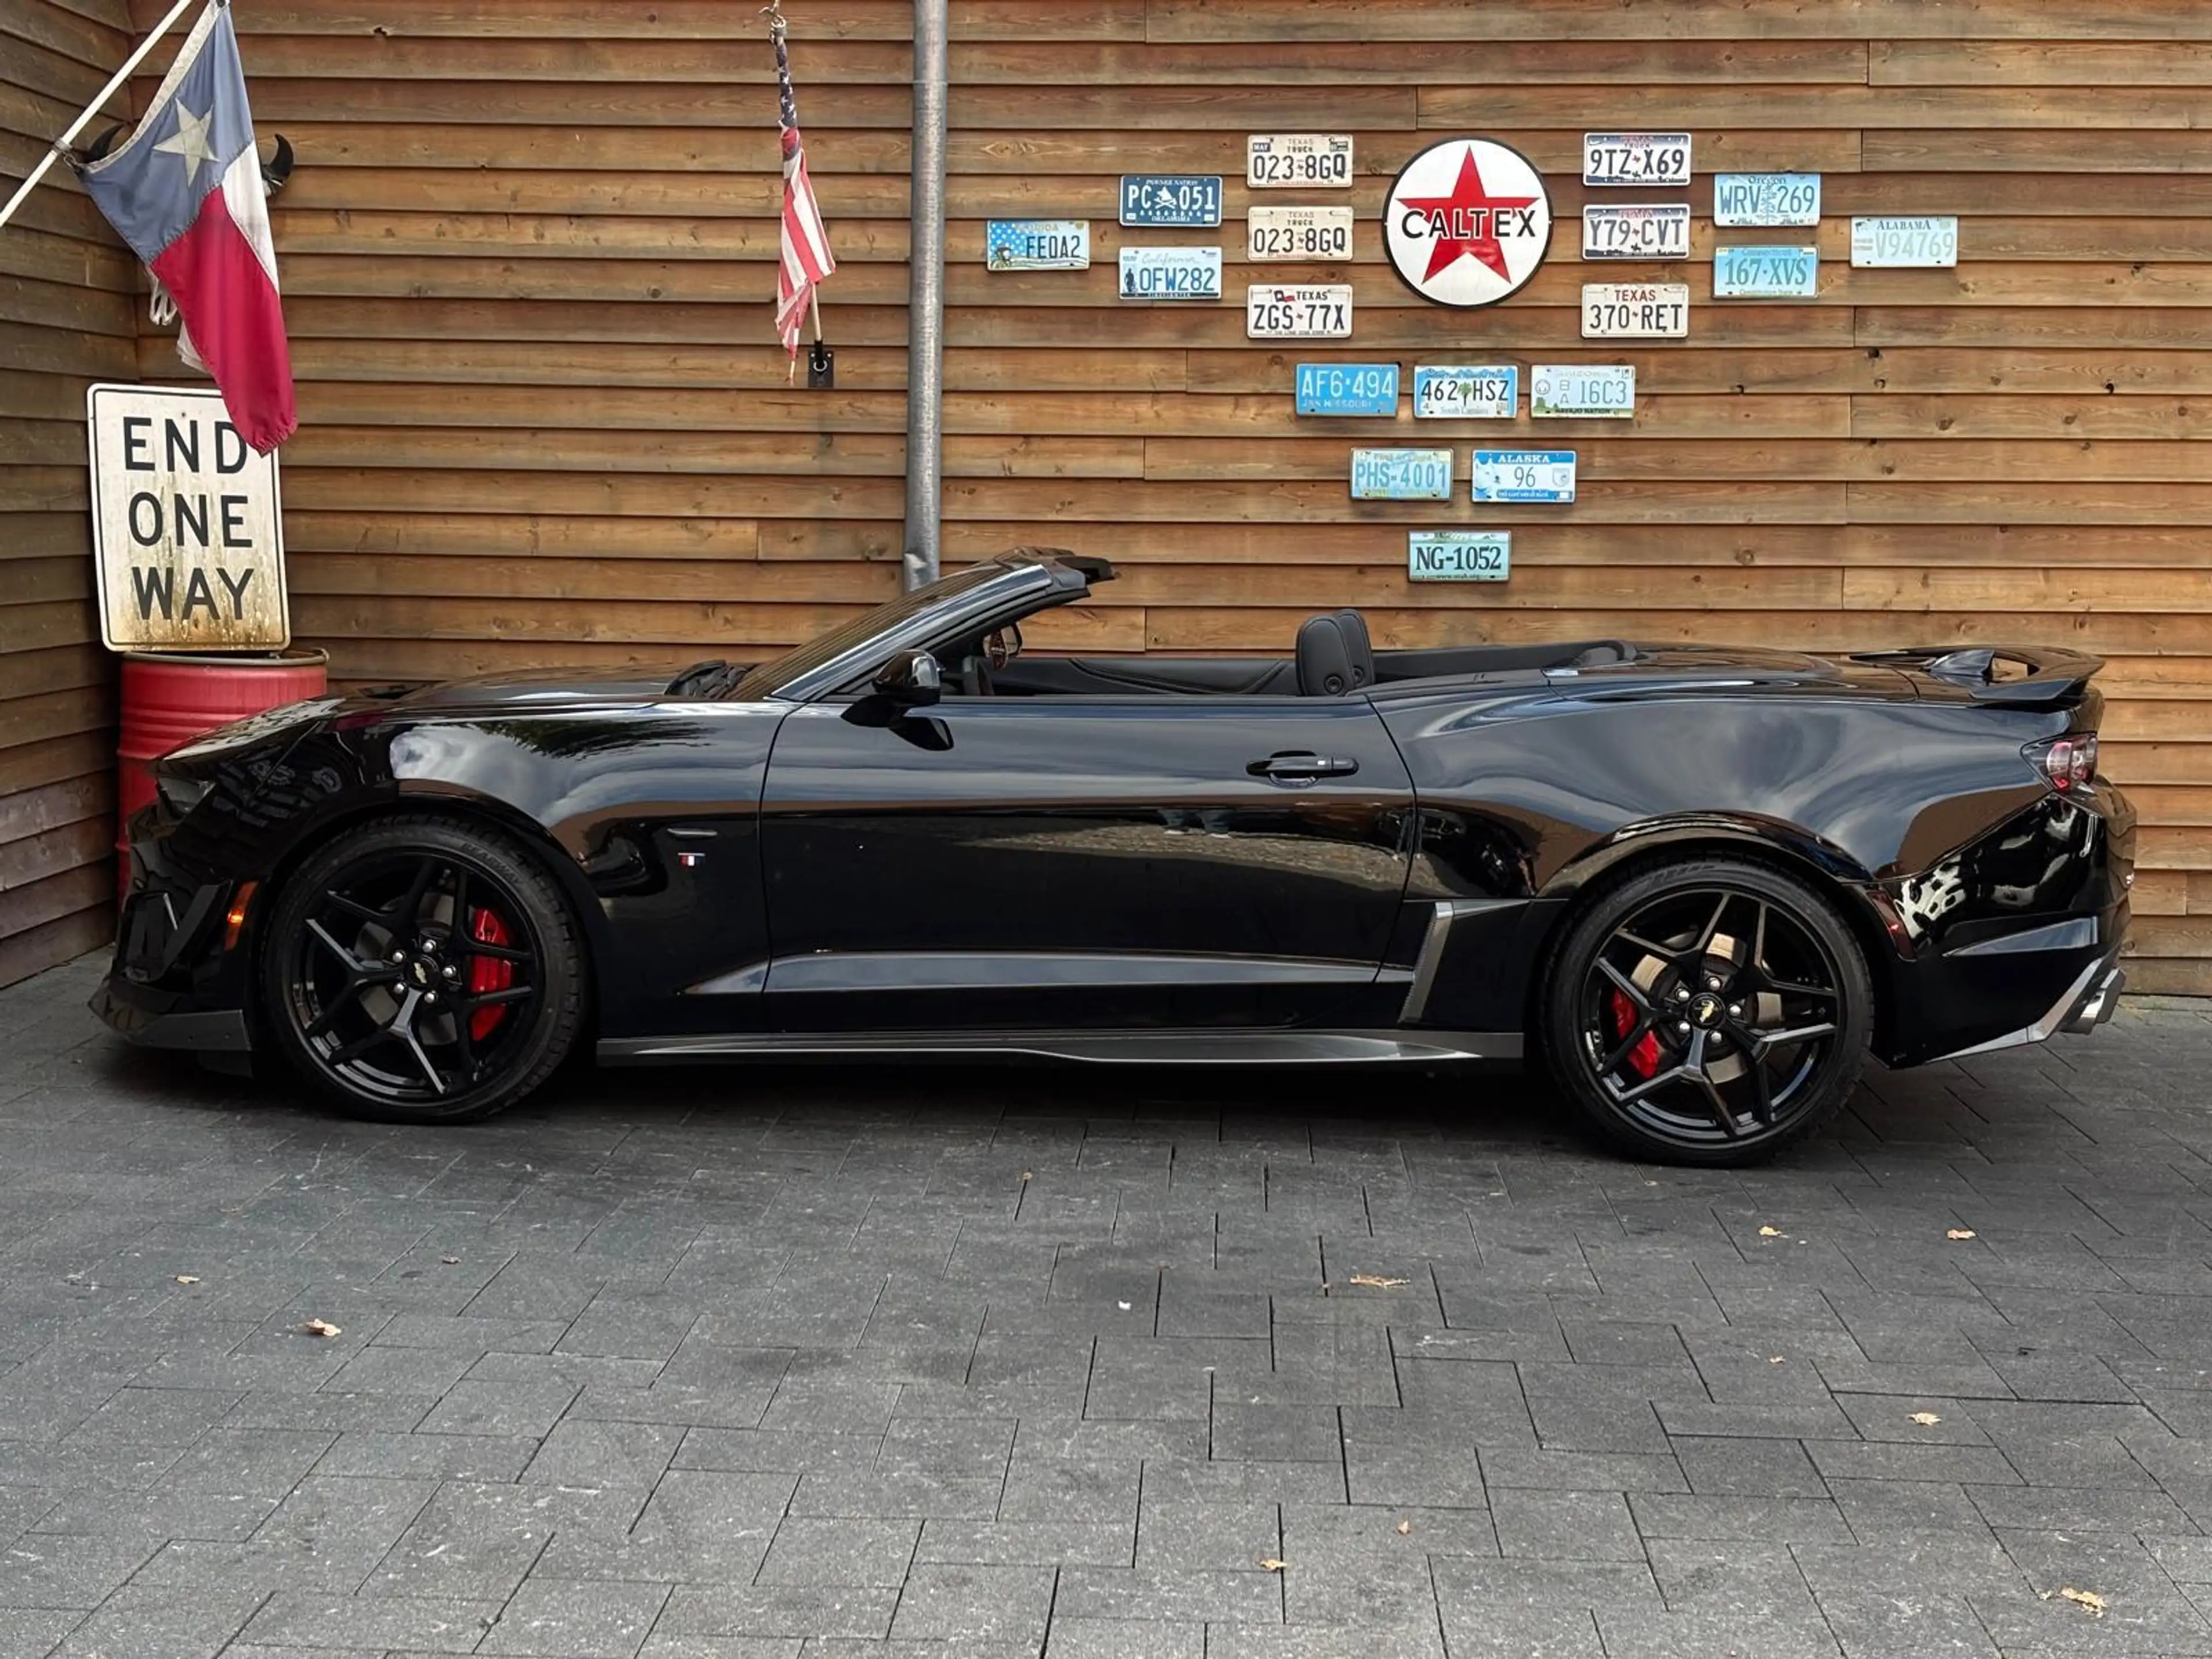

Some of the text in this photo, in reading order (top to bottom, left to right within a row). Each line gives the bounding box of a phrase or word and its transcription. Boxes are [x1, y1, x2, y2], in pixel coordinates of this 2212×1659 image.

[1590, 149, 1684, 175] 9TZ X69
[1748, 176, 1786, 185] Oregon
[1128, 185, 1215, 210] PC 051
[1719, 185, 1815, 214] WRV 269
[1402, 209, 1536, 240] CALTEX
[1590, 219, 1683, 246] Y79 CVT
[1877, 219, 1931, 230] ALABAMA
[1876, 232, 1954, 258] V94769
[1296, 290, 1328, 301] TEXAS
[1615, 289, 1656, 302] TEXAS
[1253, 304, 1344, 330] ZGS 77X
[1589, 304, 1683, 330] 370 RET
[1301, 370, 1393, 398] AF6 494
[1421, 380, 1509, 402] 462 HSZ
[1580, 380, 1627, 404] 16C3
[123, 416, 247, 474] END
[1498, 454, 1551, 463] ALASKA
[1355, 462, 1446, 488] PHS-4001
[1514, 466, 1536, 488] 96
[128, 491, 252, 548] ONE
[1415, 546, 1502, 570] NG-1052
[131, 566, 255, 621] WAY
